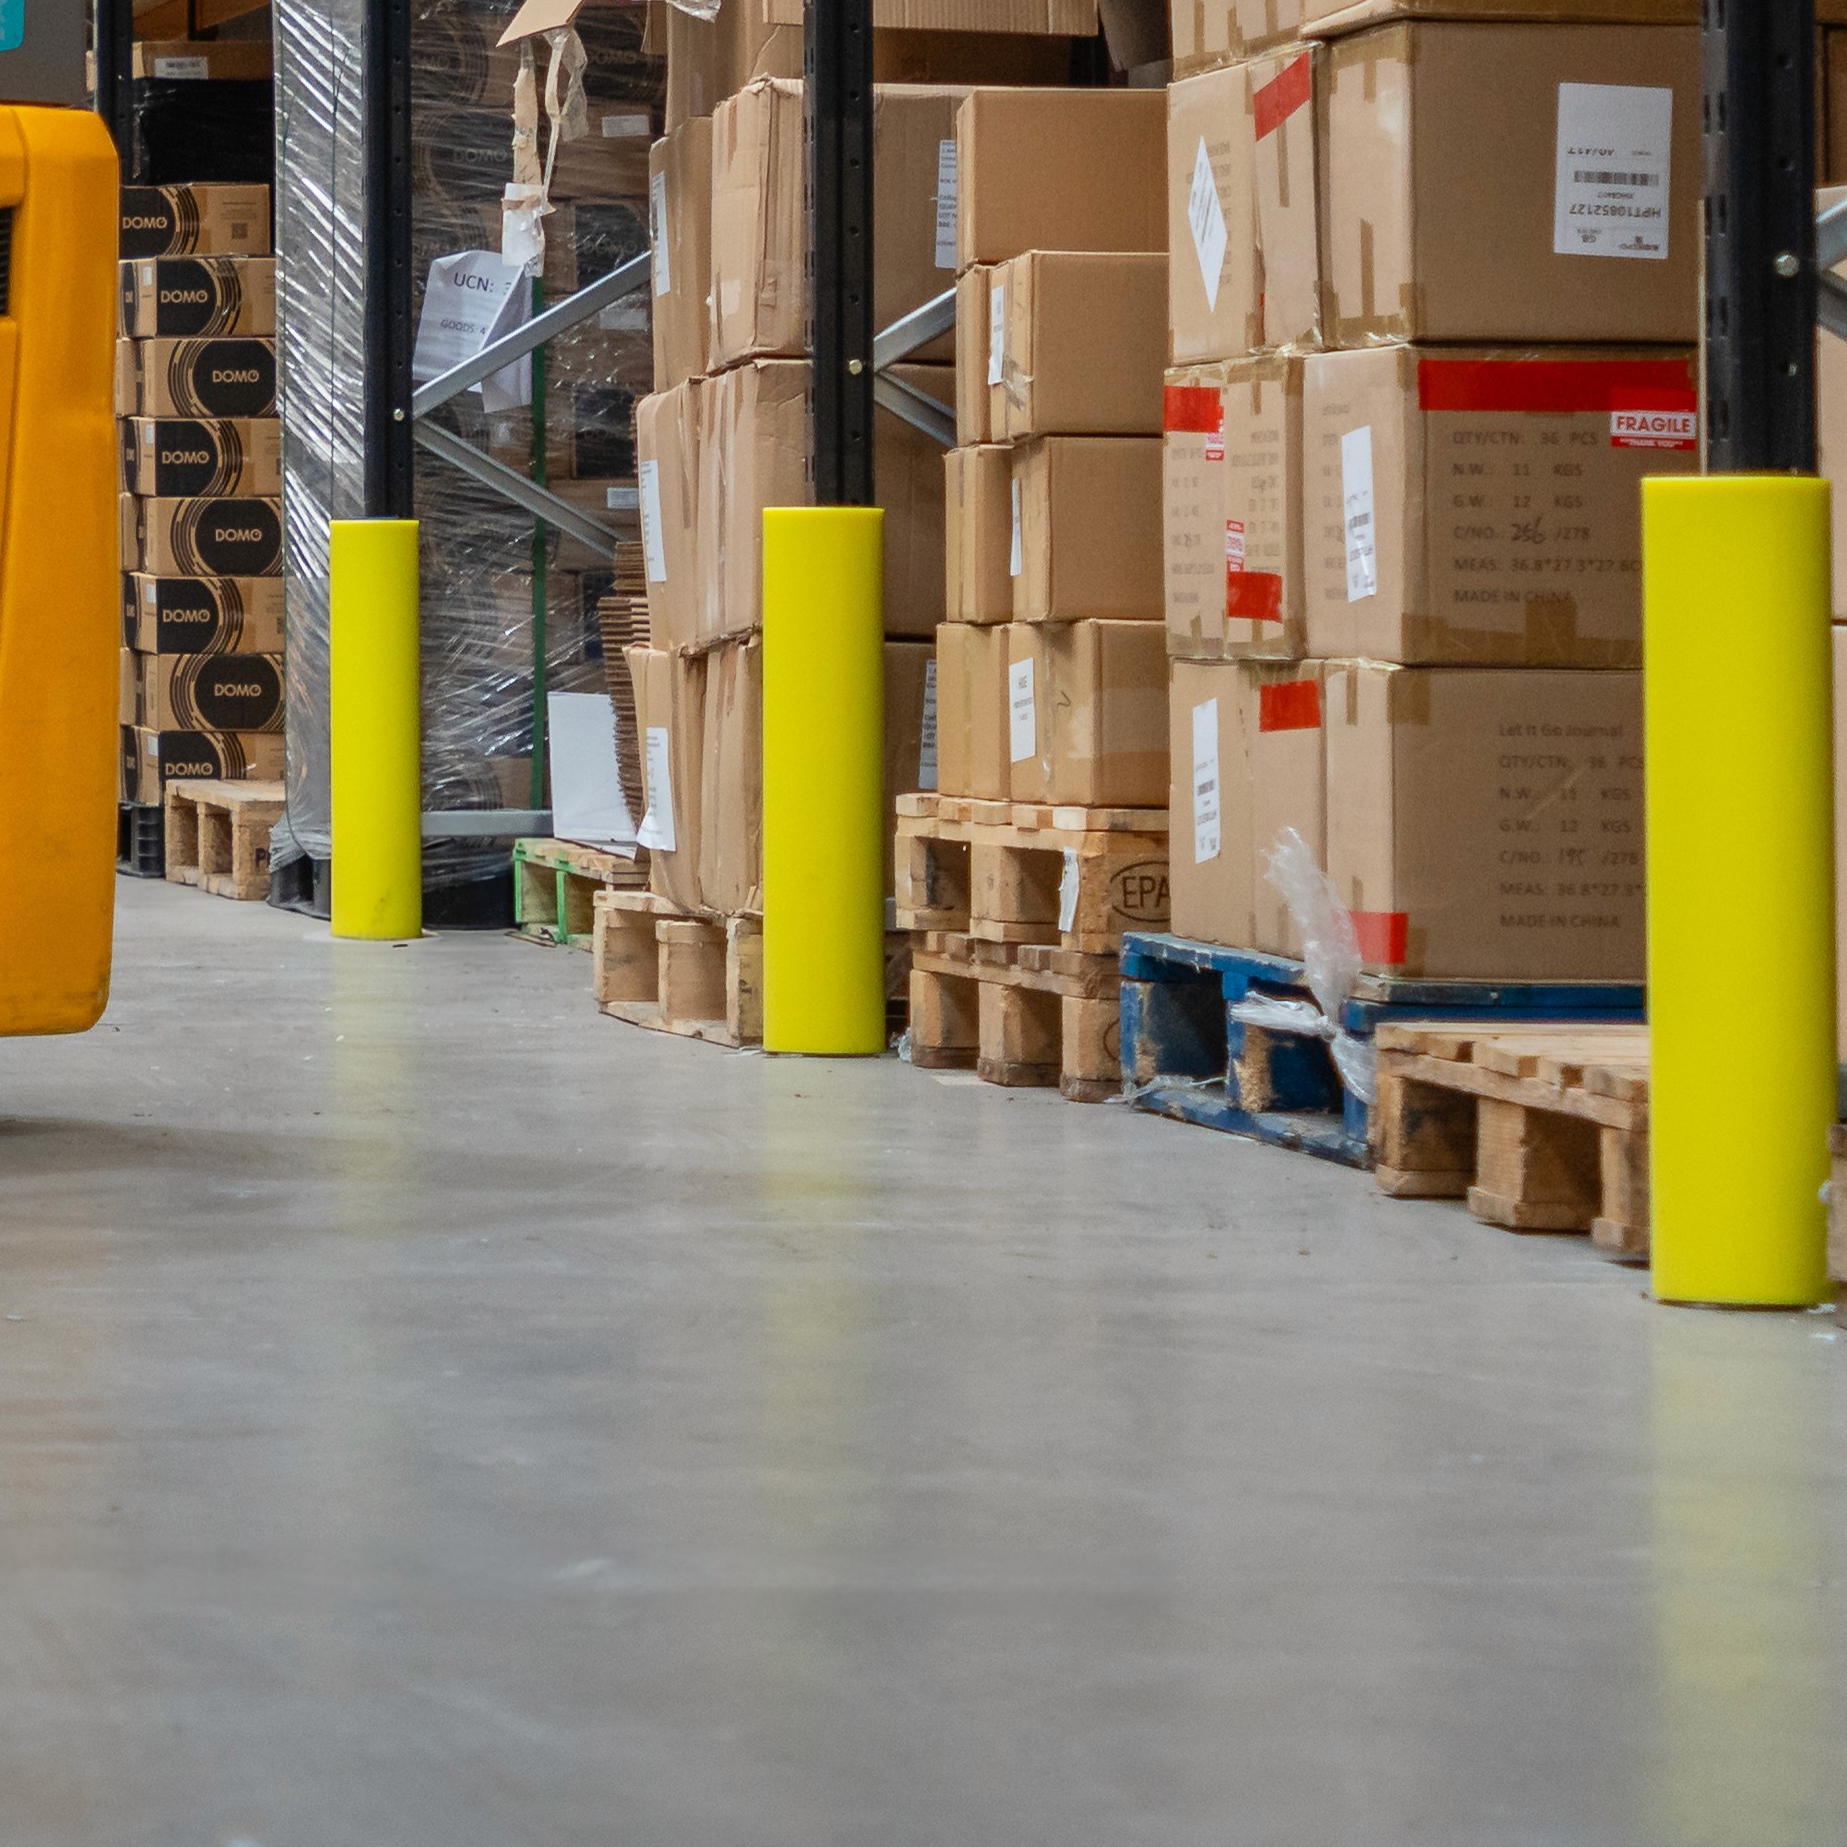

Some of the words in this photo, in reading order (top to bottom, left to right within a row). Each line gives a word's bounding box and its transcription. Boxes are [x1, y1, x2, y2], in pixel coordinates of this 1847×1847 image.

[122, 216, 168, 229] DOMO
[454, 272, 494, 293] UCN:
[160, 290, 207, 303] DOMO
[212, 370, 259, 383] DOMO
[1615, 416, 1691, 433] FRAGILE
[1569, 432, 1598, 445] PCS
[161, 451, 209, 464] DOMO
[215, 529, 262, 542] DOMO
[1454, 590, 1500, 603] MADE
[1504, 590, 1520, 603] IN
[1524, 590, 1572, 604] CHINA
[162, 609, 210, 622] DOMO
[214, 684, 262, 697] DOMO
[165, 762, 213, 776] DOMO
[1499, 914, 1546, 928] MADE
